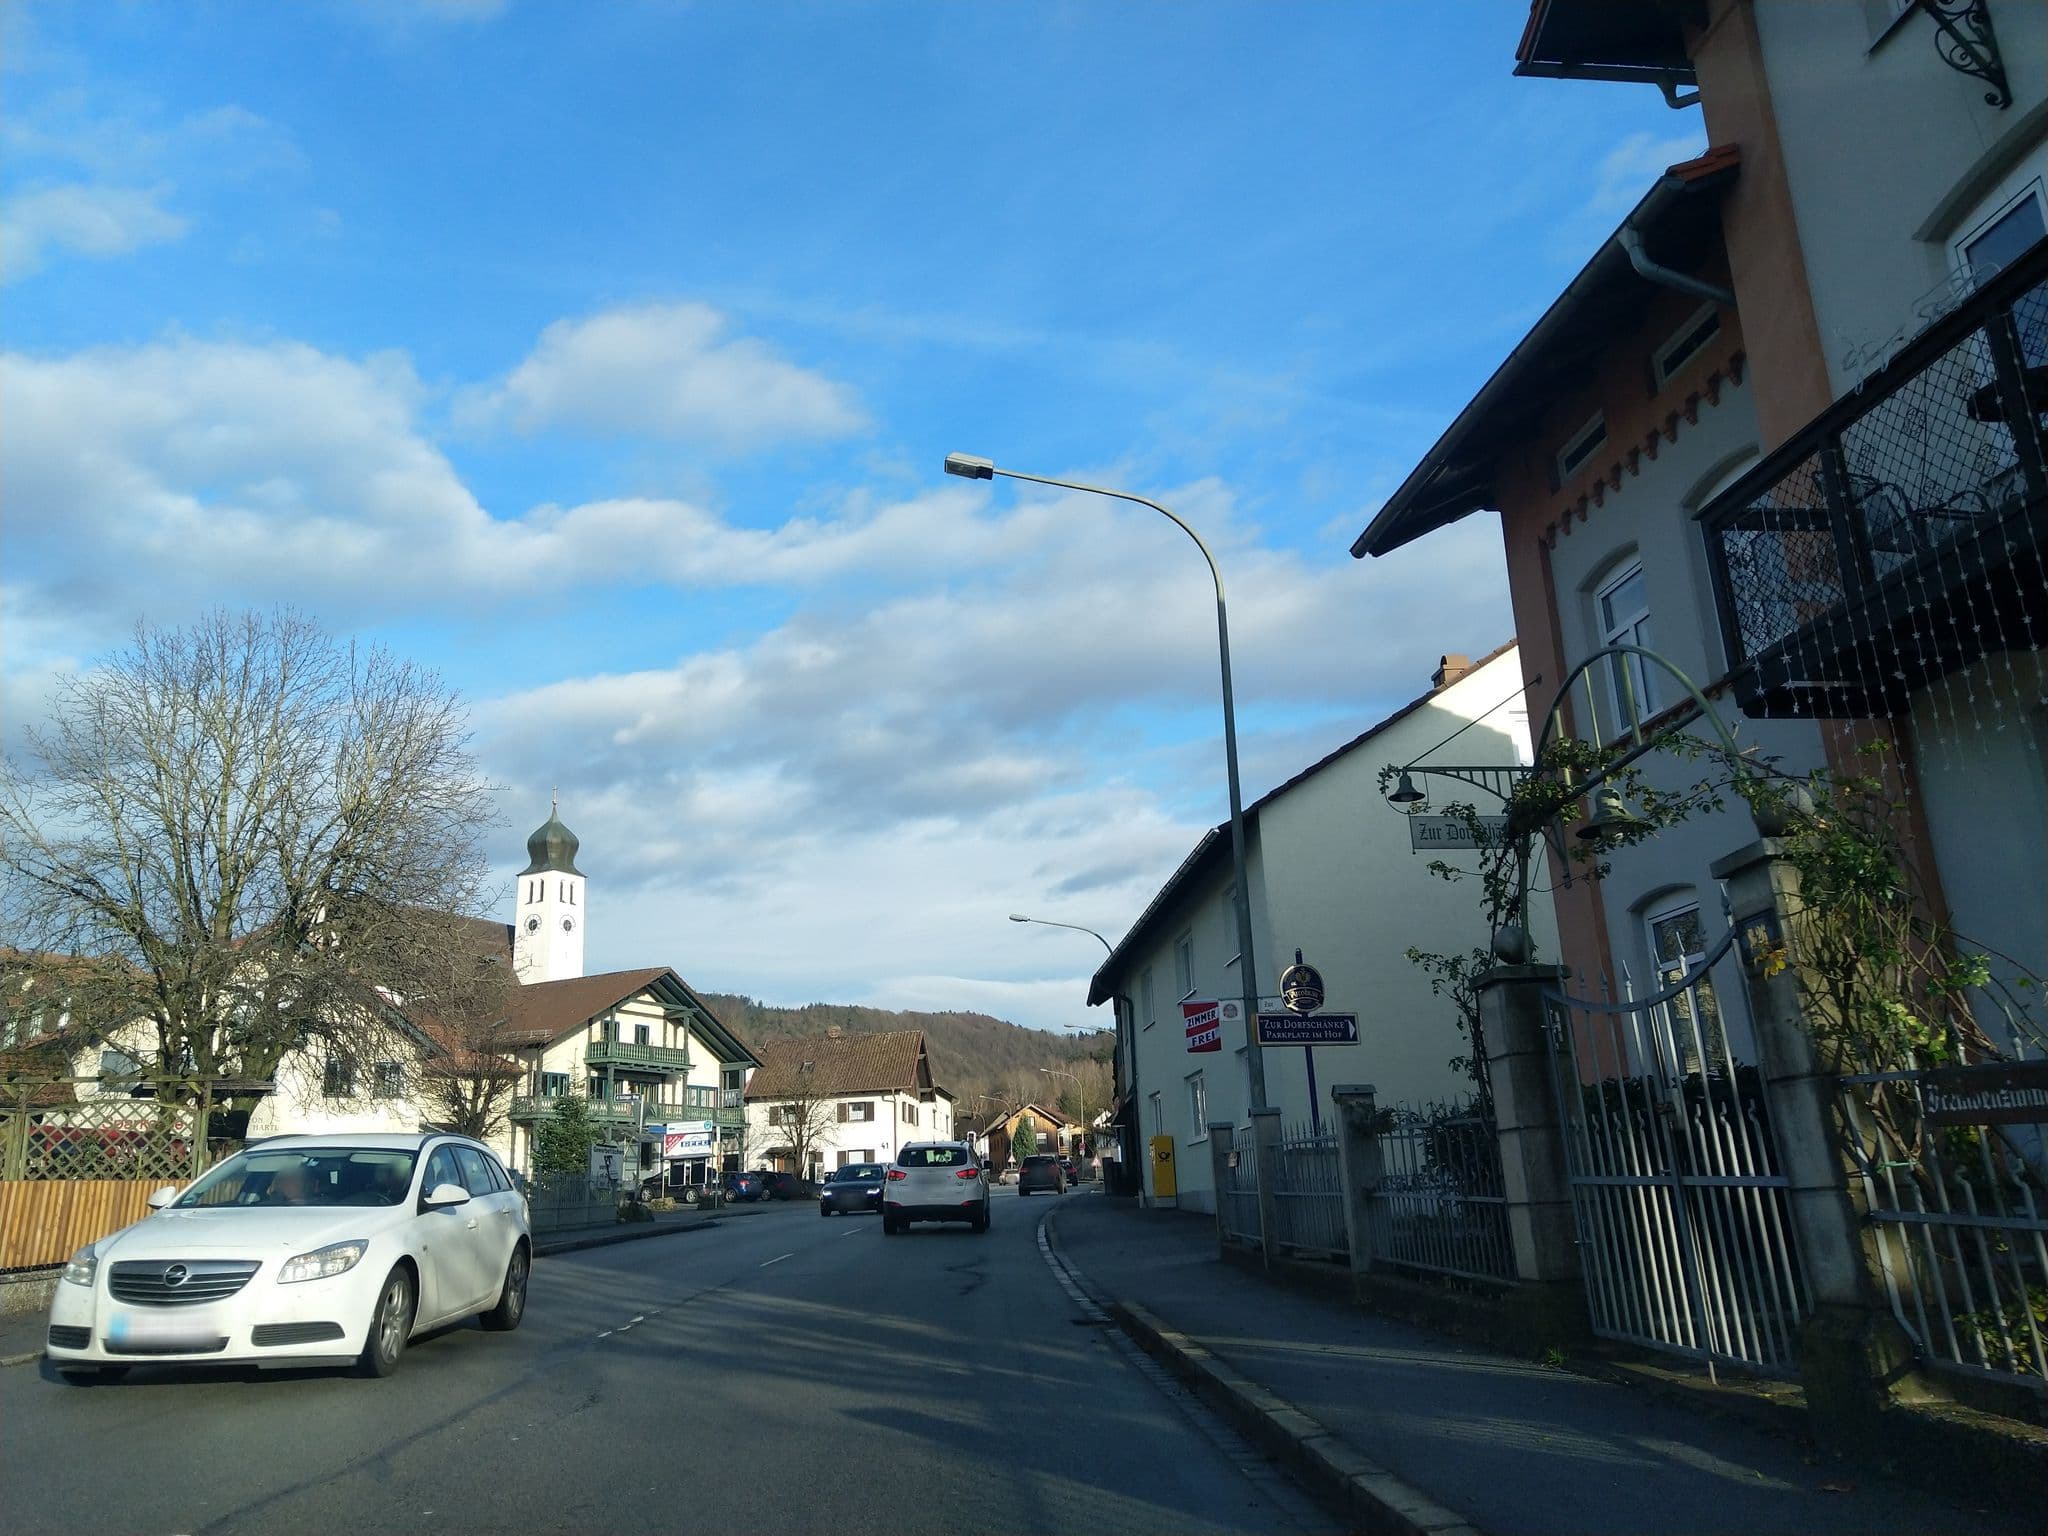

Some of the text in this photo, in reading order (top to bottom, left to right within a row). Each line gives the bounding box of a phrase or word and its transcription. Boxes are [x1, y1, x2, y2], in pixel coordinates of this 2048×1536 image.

[1418, 823, 1442, 841] Zur
[1187, 1010, 1216, 1027] ZIMMER
[1192, 1031, 1216, 1046] FREI
